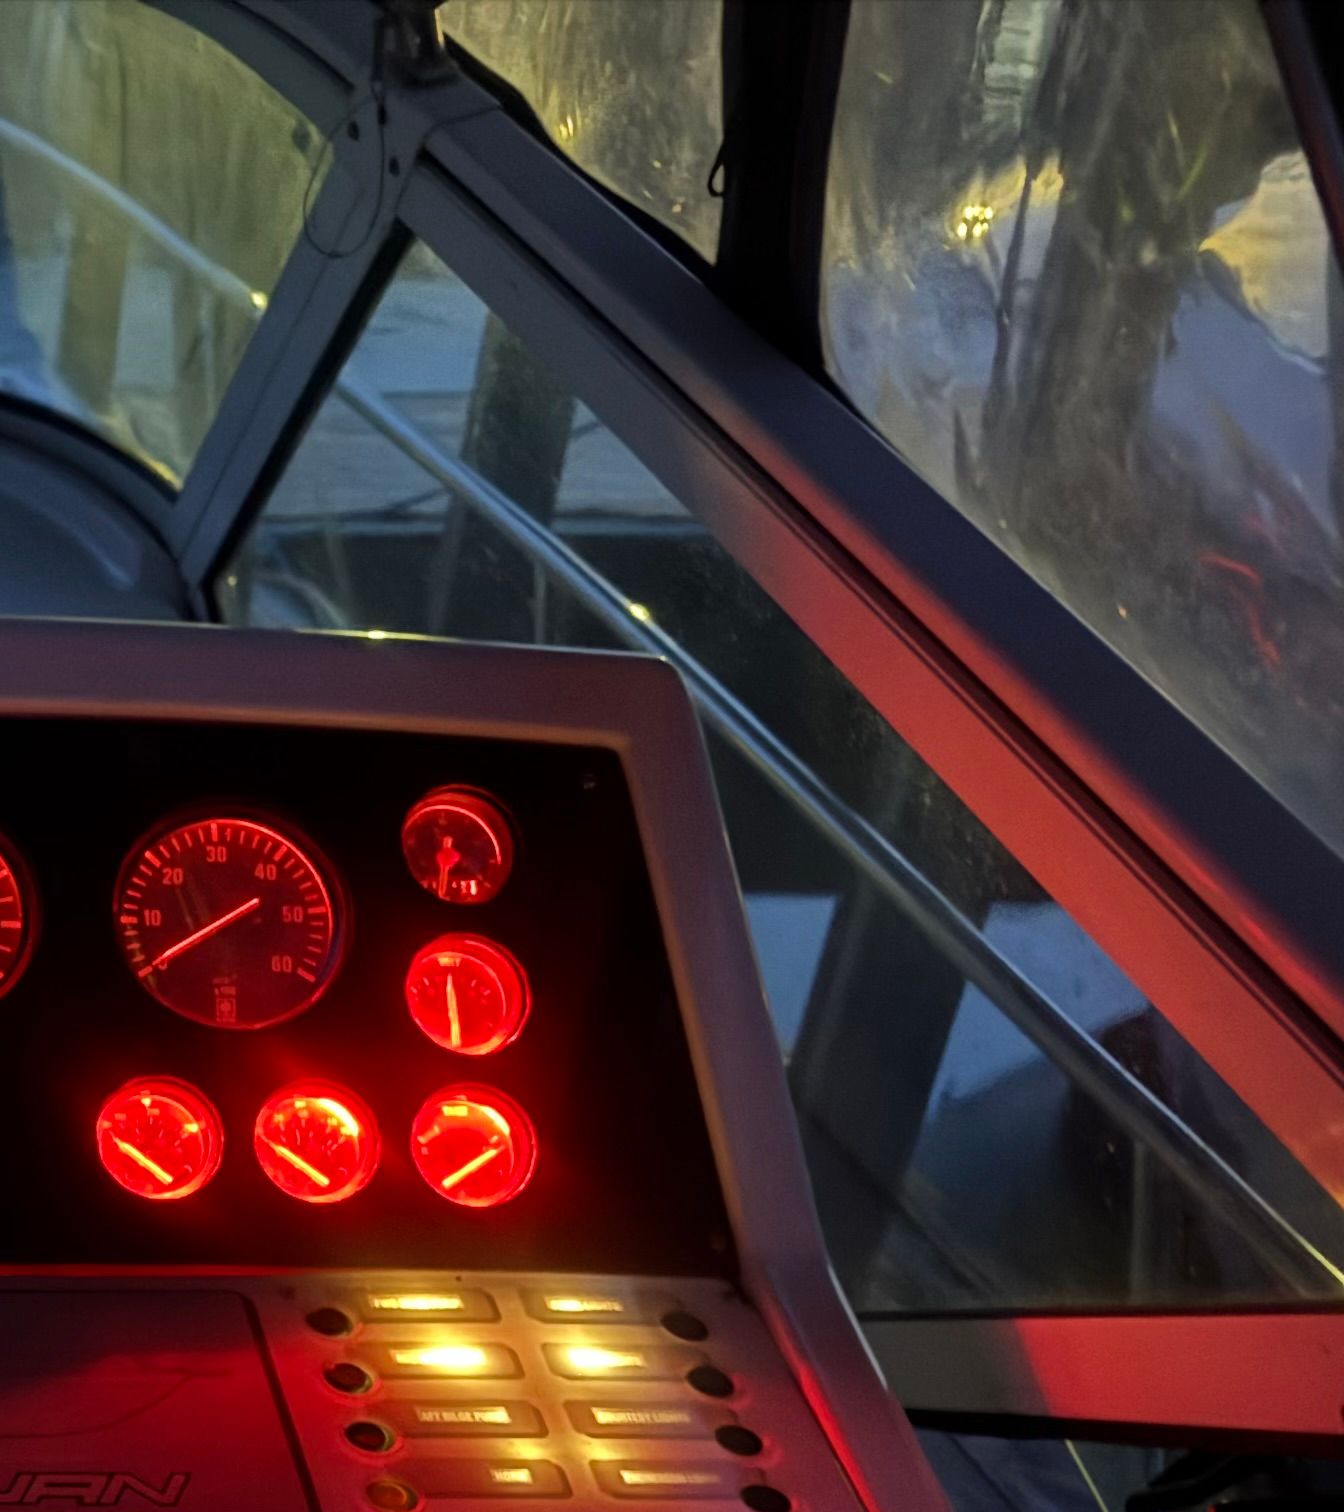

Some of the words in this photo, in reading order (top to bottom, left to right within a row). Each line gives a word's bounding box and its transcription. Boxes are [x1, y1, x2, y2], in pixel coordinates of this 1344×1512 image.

[205, 846, 227, 863] 30
[162, 868, 184, 885] 20
[254, 863, 277, 881] 40
[143, 909, 162, 927] 10
[282, 905, 303, 923] 50
[271, 955, 293, 973] 60
